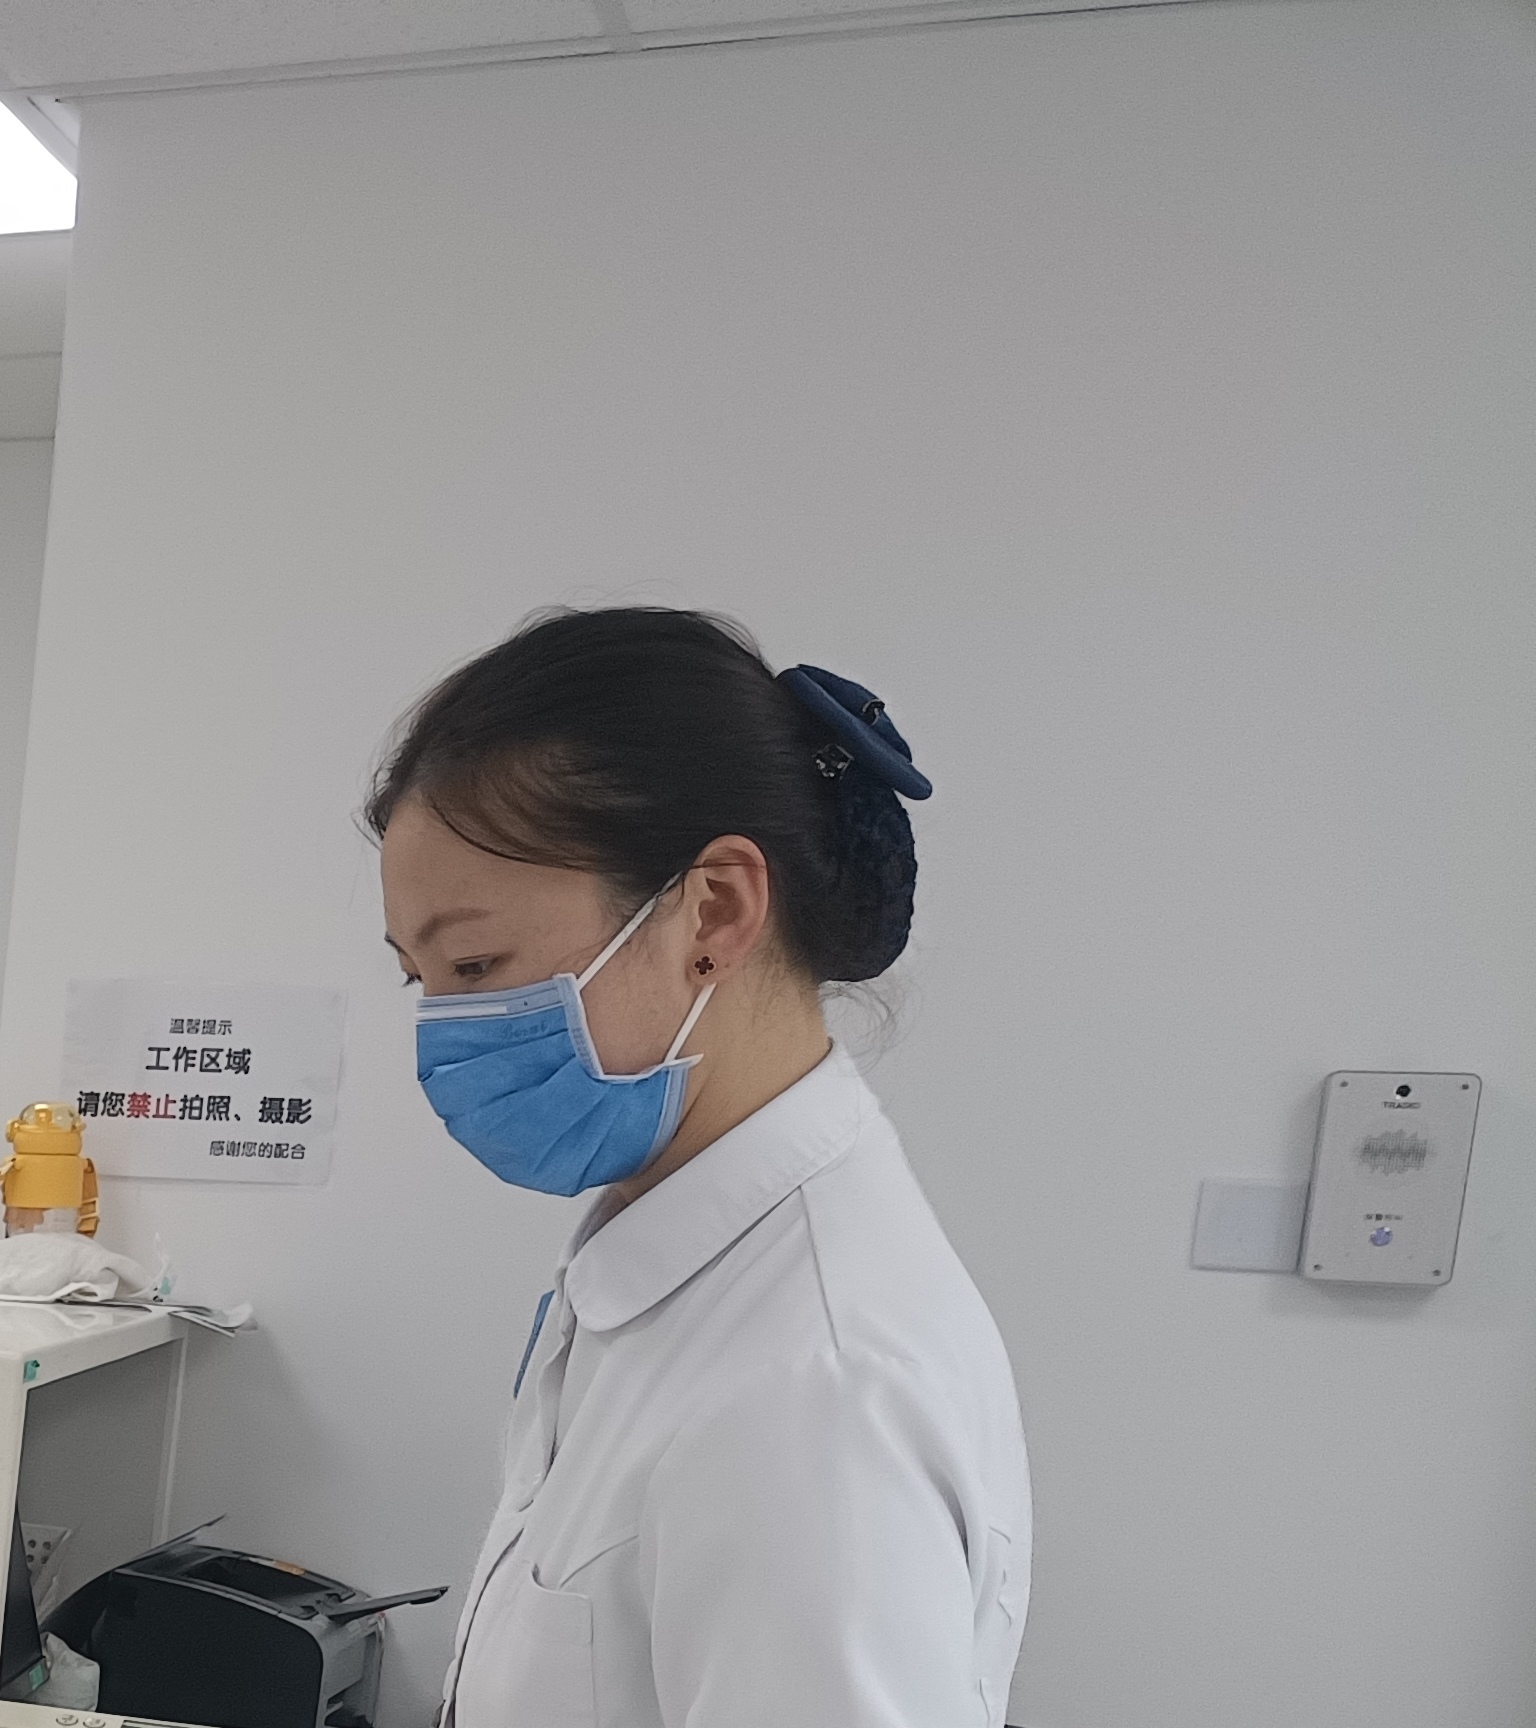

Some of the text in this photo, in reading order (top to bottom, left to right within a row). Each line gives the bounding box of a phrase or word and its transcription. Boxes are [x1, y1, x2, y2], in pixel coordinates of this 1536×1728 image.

[169, 1018, 232, 1035] 温馨提示
[145, 1046, 251, 1074] 工作区域
[77, 1091, 312, 1124] 请您禁止拍照、摄影
[209, 1141, 306, 1159] 感谢您的配合
